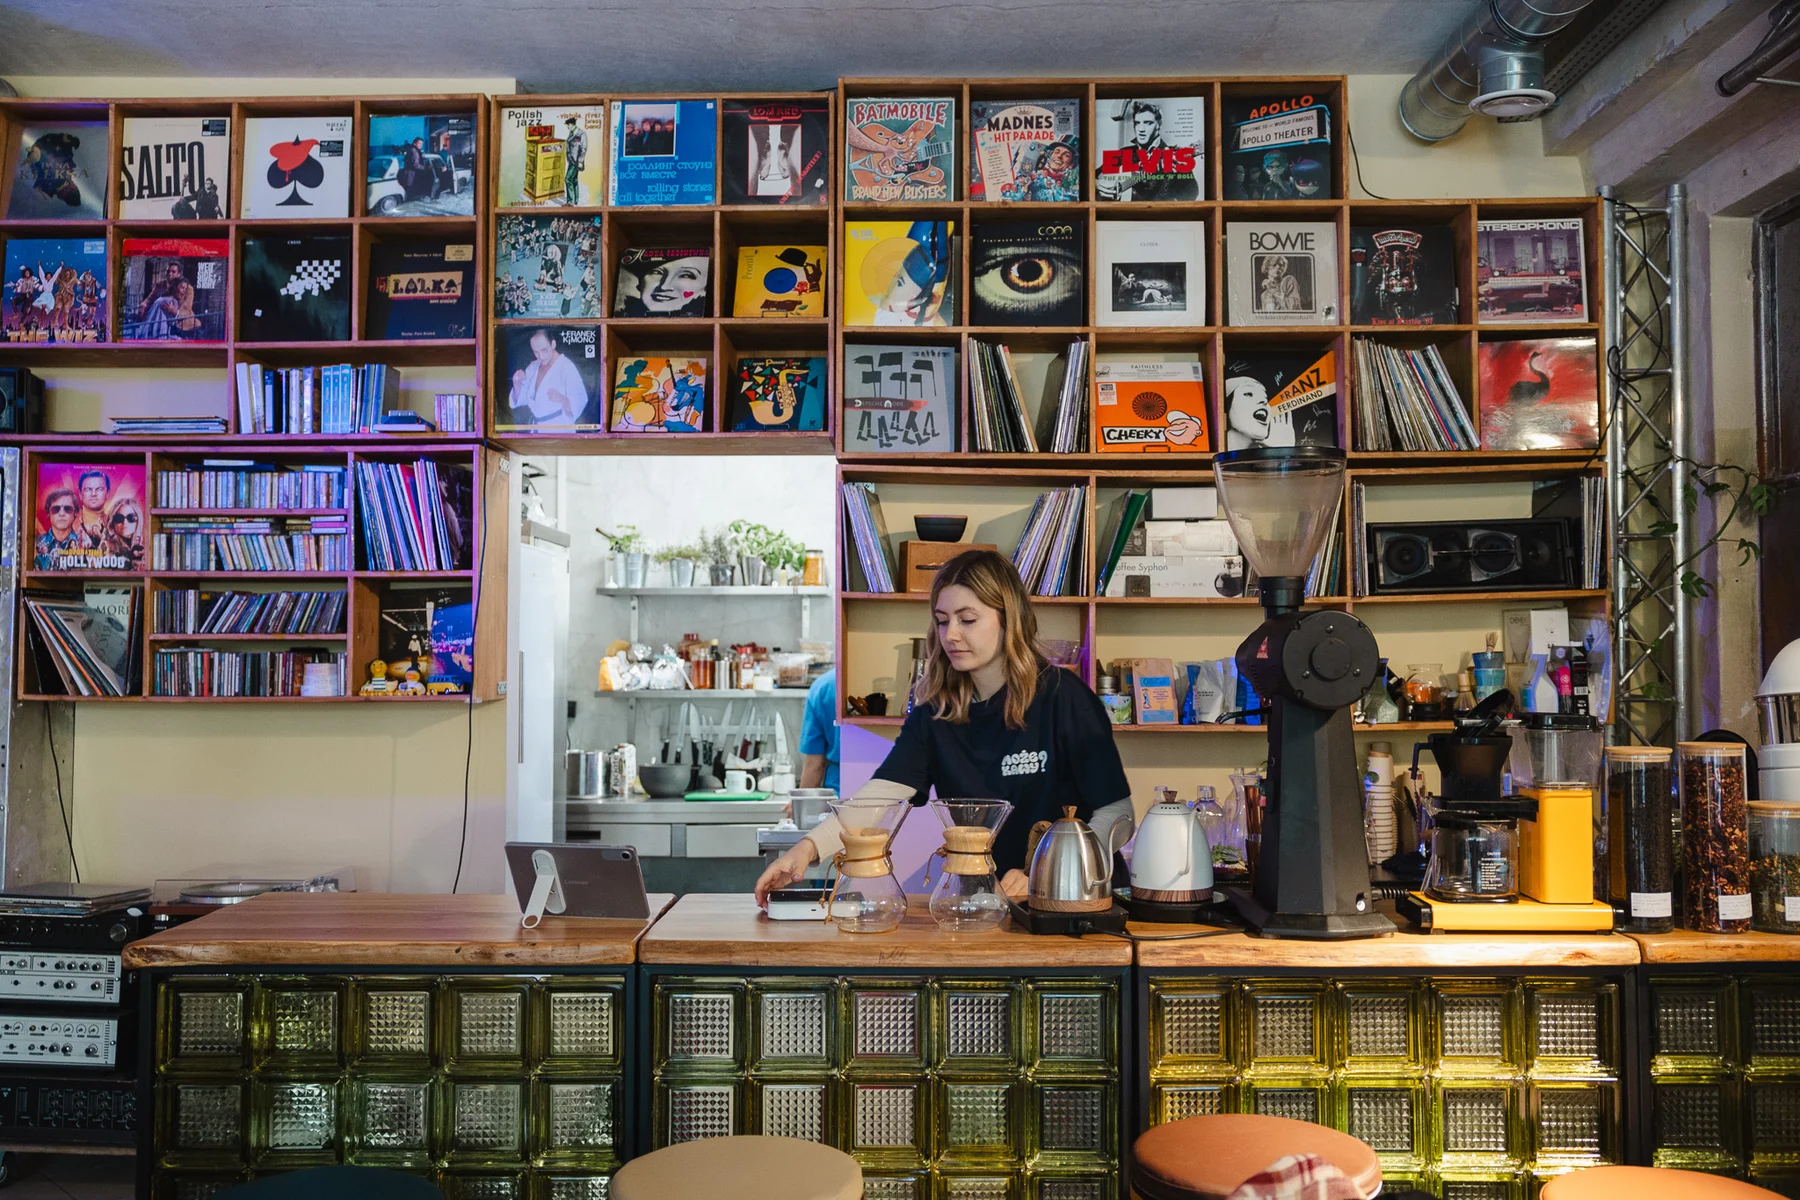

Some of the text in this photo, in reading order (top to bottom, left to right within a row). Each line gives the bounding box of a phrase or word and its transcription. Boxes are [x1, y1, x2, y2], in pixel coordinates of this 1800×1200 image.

[1249, 95, 1314, 119] APOLLO
[508, 110, 542, 119] Polish
[854, 102, 948, 127] BATMOBILE
[1274, 119, 1291, 127] WORLD
[1292, 114, 1314, 124] FAMOUS
[516, 119, 542, 128] jazz
[994, 131, 1054, 143] HIT PARADE
[1241, 126, 1314, 146] APOLLO THEATER
[1101, 147, 1196, 174] ELVIS
[120, 141, 205, 201] SALTO
[647, 182, 713, 194] rolling stones
[852, 185, 880, 200] BRAND
[619, 192, 677, 203] all together
[1477, 222, 1580, 232] STEREOPHONIC
[1249, 232, 1315, 251] BOWIE
[7, 329, 49, 343] THE
[54, 328, 98, 343] WIZ
[1280, 368, 1327, 401] FRANZ
[854, 399, 904, 408] DEPECHE MODE
[1277, 389, 1323, 413] FERDINAND
[1106, 428, 1164, 440] CHEEKY
[60, 555, 125, 569] HOLLYWOOD
[1115, 563, 1168, 572] offee Syphon
